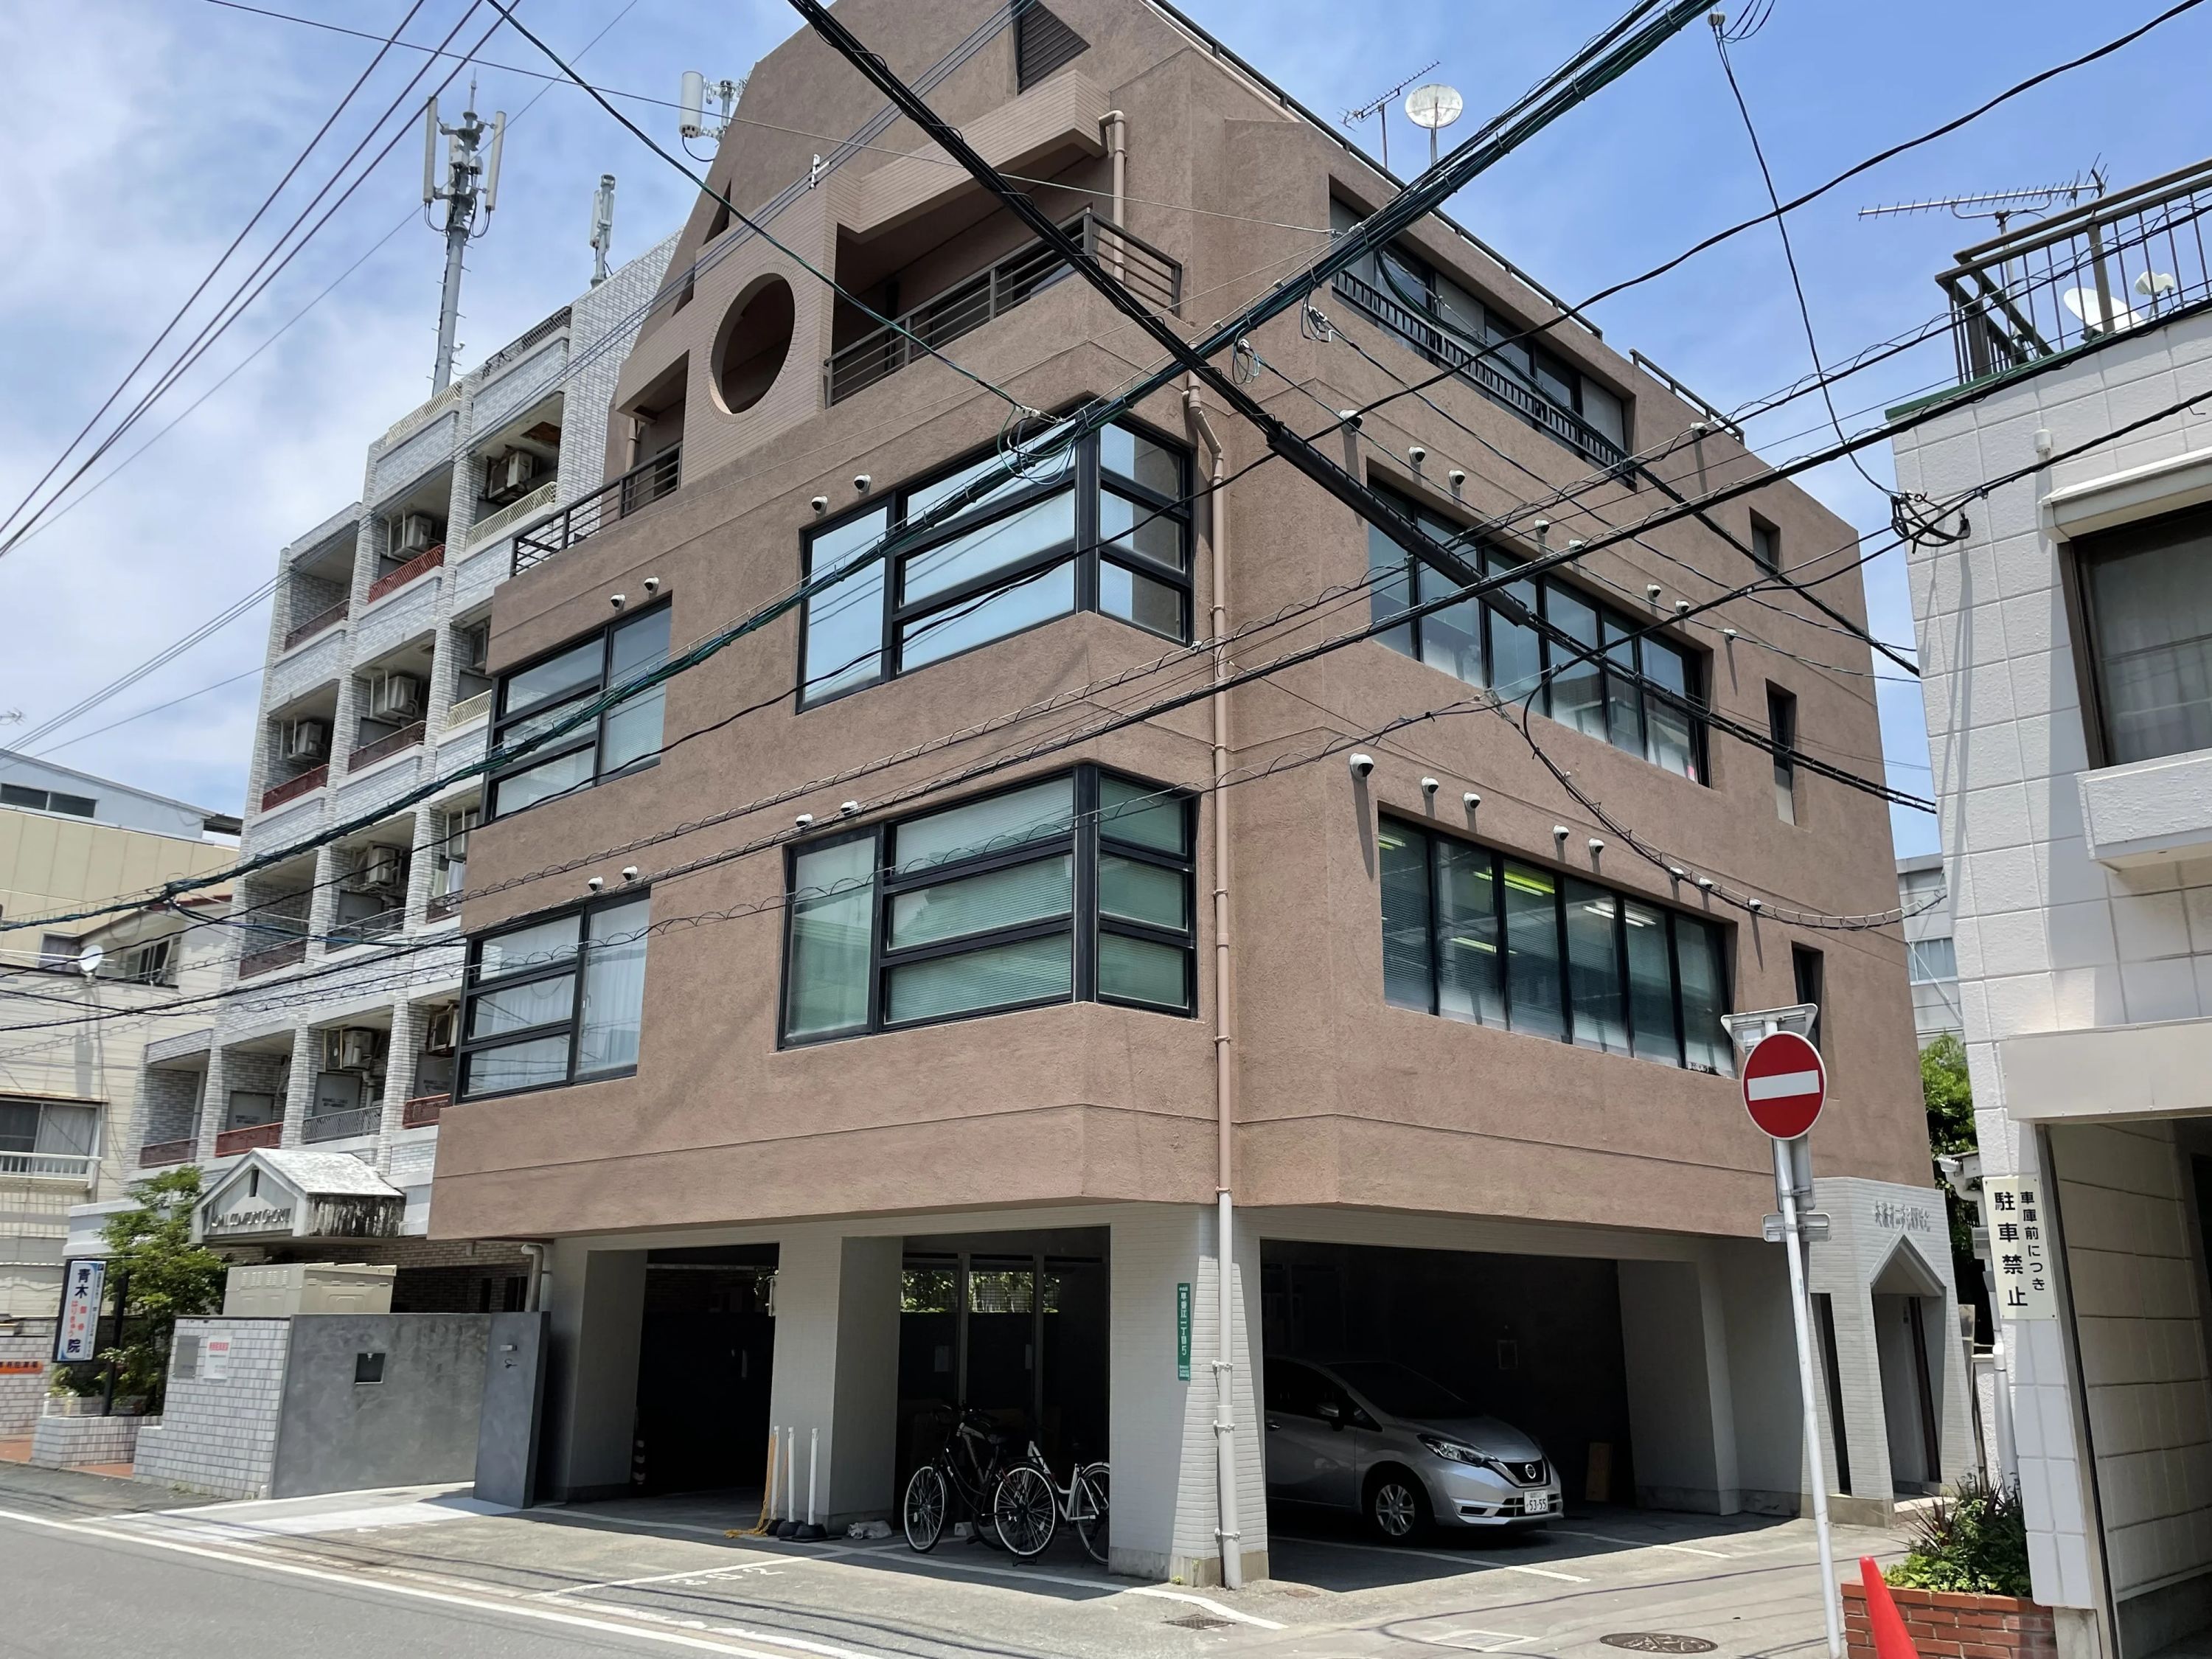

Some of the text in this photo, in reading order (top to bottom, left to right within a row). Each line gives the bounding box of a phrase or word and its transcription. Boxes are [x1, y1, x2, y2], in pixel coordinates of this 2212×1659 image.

[1994, 1192, 2028, 1307] 駐車禁止
[2020, 1192, 2045, 1291] 車庫前につき
[74, 1268, 91, 1298] 青木
[66, 1338, 81, 1353] 院
